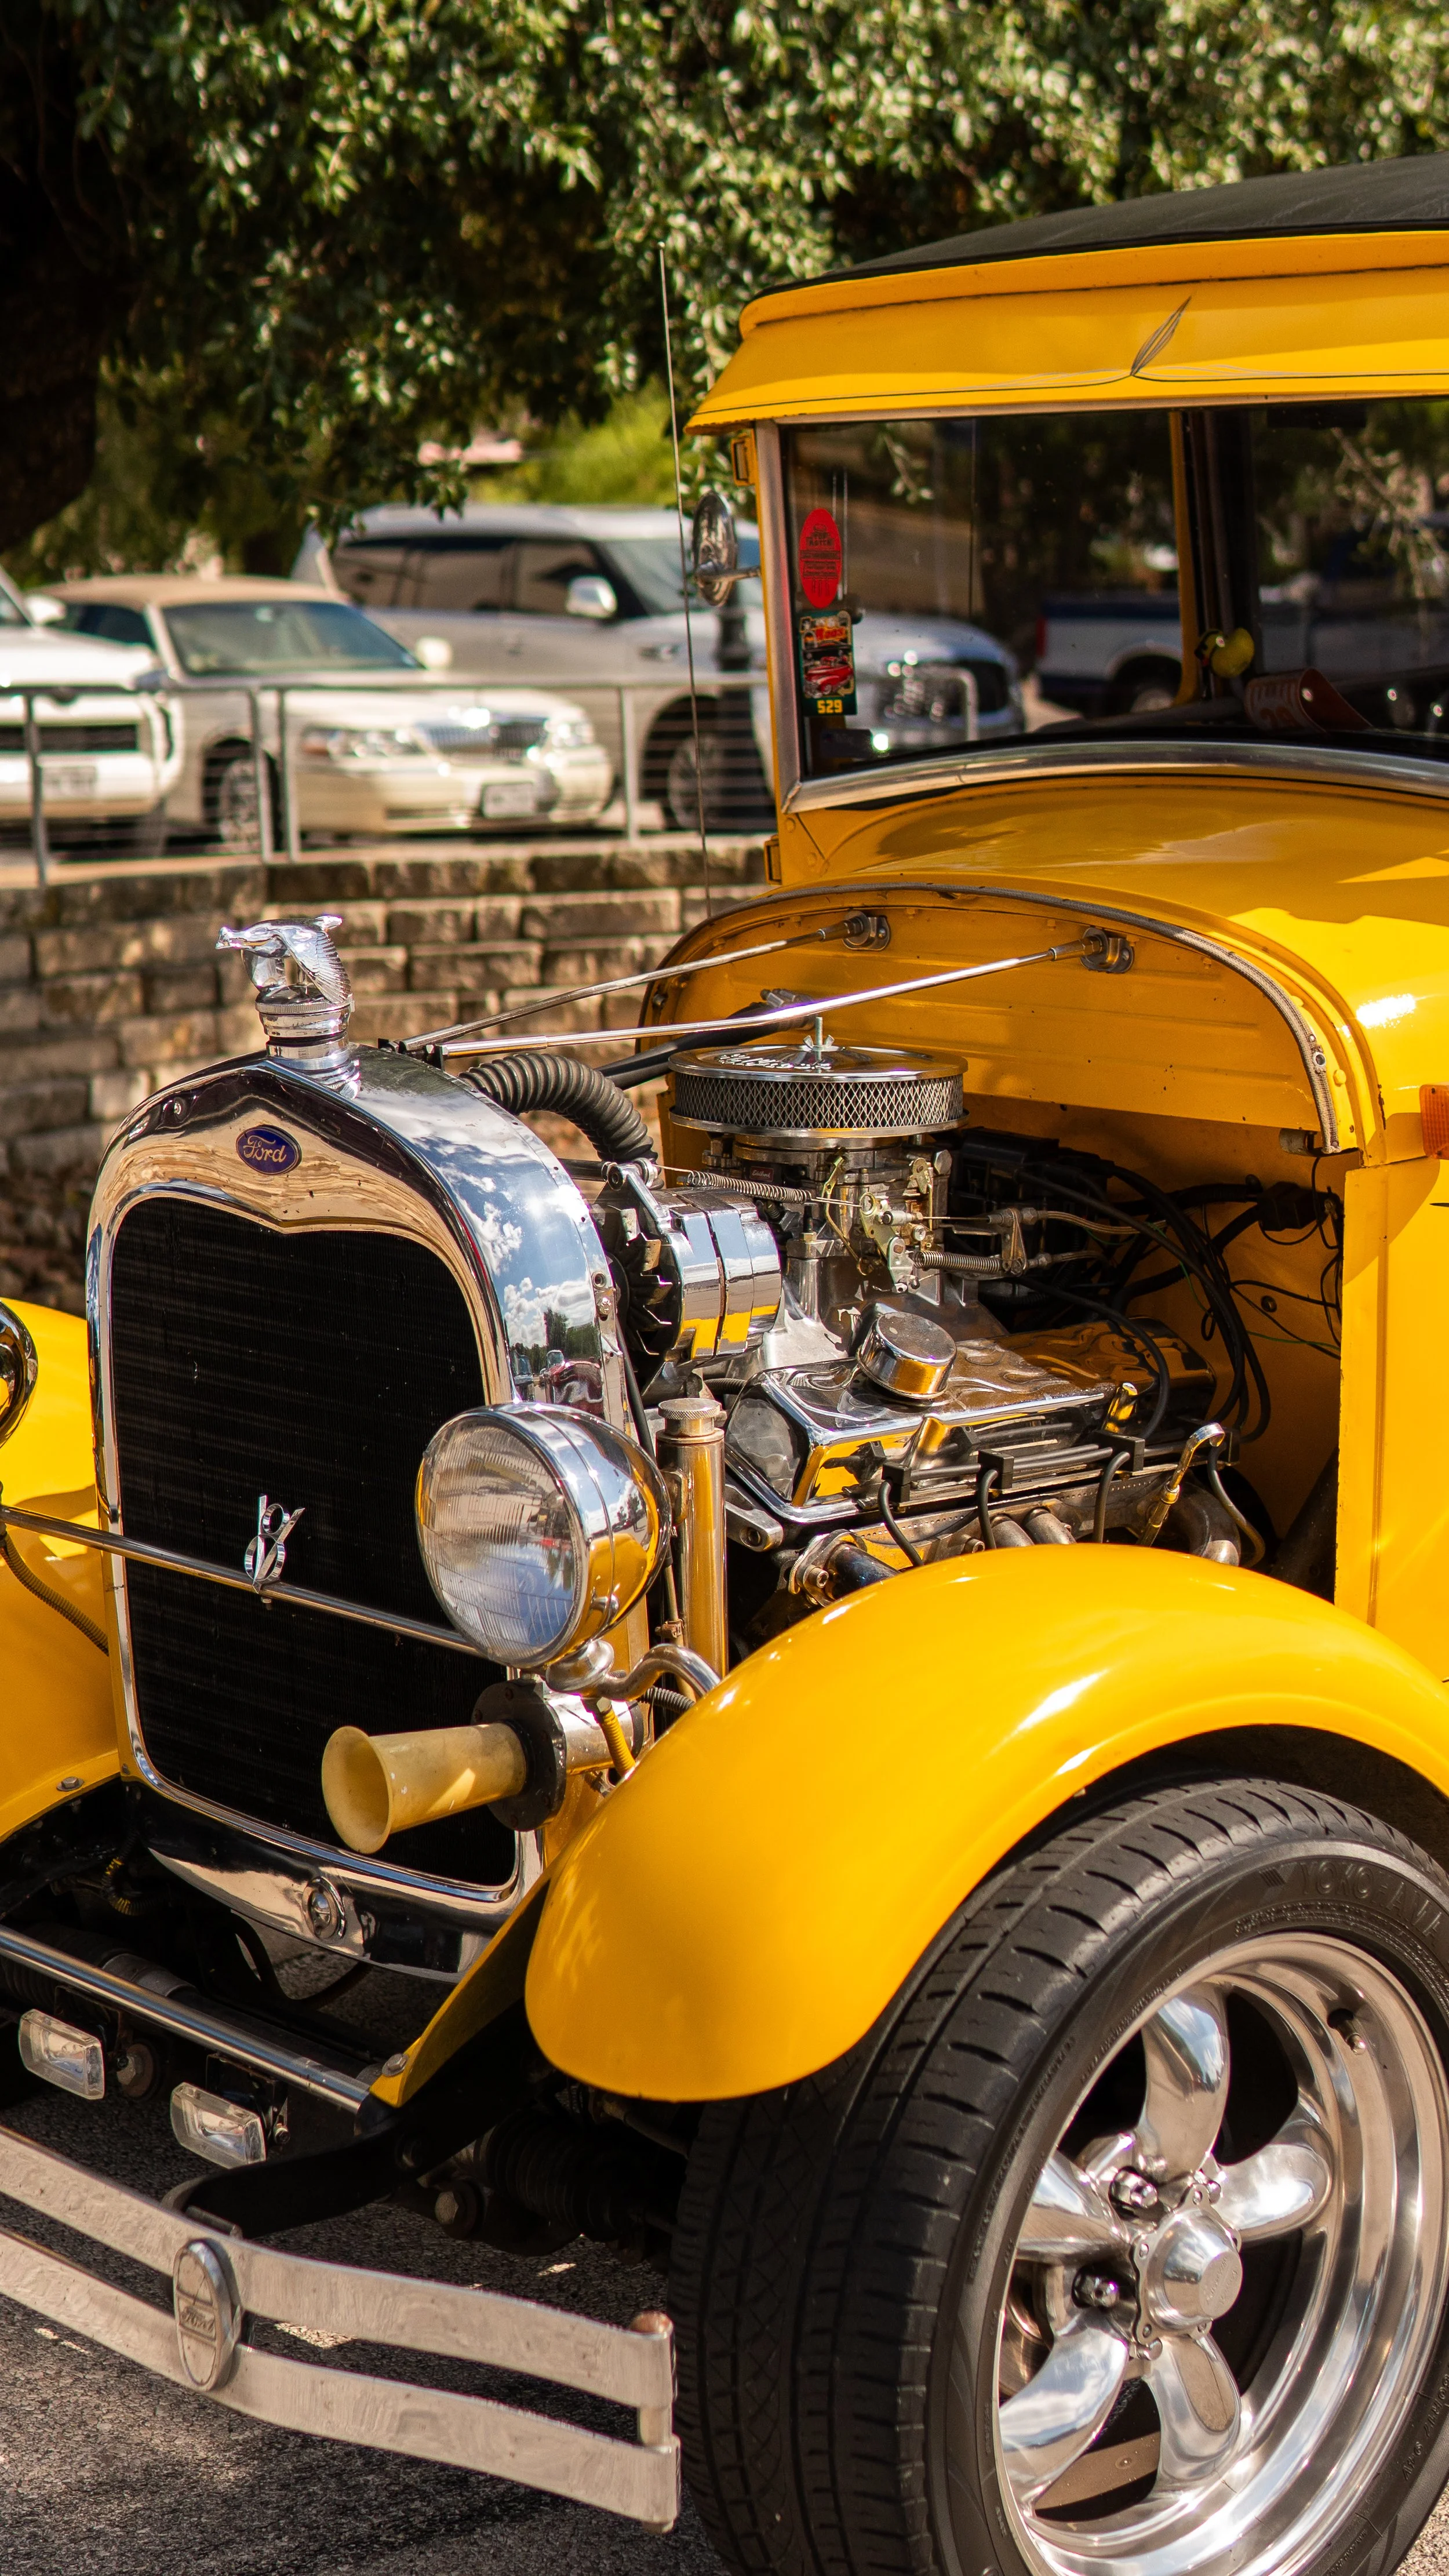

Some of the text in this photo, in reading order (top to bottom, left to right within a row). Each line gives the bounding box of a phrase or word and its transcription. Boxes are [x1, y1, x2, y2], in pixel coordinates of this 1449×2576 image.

[817, 700, 843, 714] 529
[243, 1135, 286, 1162] Ford
[1299, 1860, 1443, 1945] YOKOHAMA
